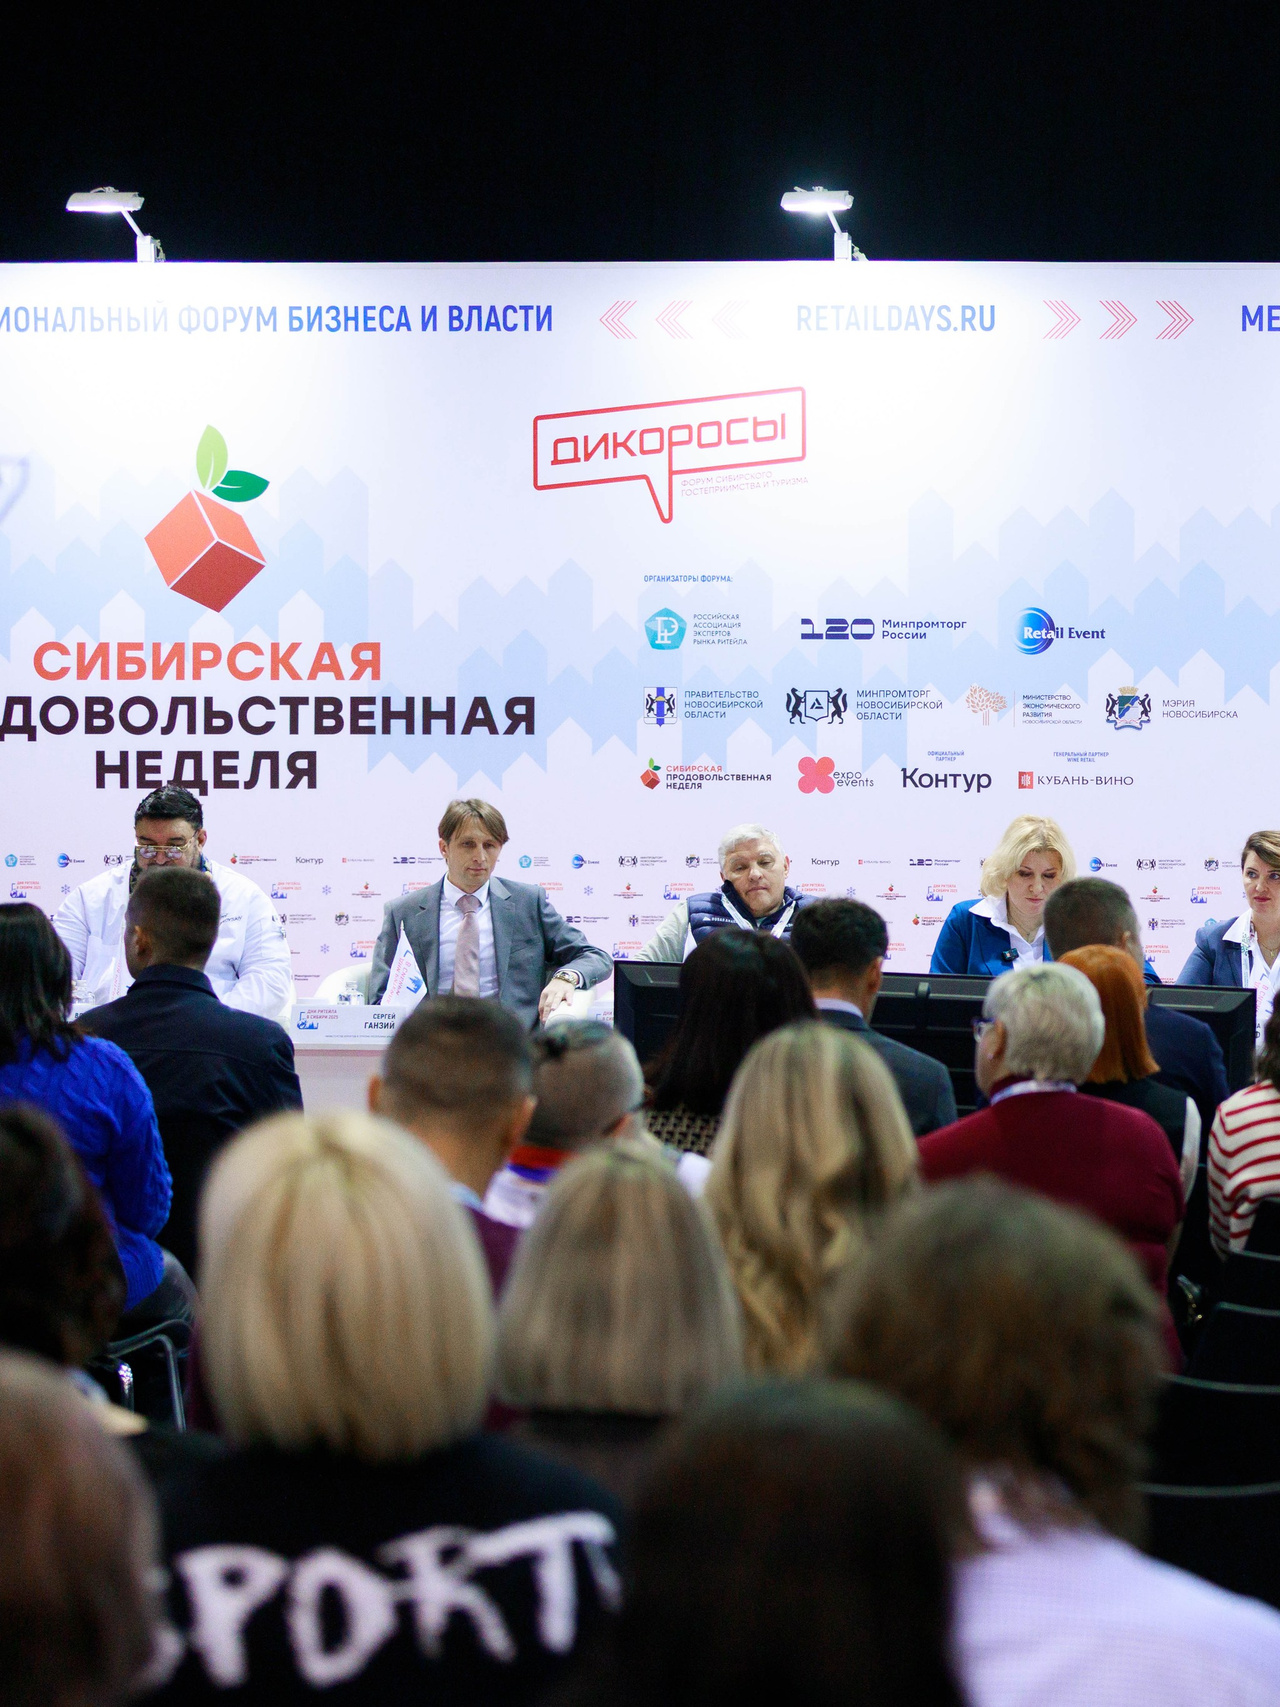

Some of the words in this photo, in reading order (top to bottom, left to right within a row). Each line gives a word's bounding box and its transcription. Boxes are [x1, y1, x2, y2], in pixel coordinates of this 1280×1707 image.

[178, 305, 278, 334] ФОРУМ
[288, 304, 412, 332] БИЗНЕСА
[420, 306, 438, 332] И
[448, 304, 552, 332] ВЛАСТИ
[796, 304, 996, 332] RETAILDAYS.RU
[551, 413, 786, 467] ДИКОРОСЫ
[681, 476, 714, 487] ФОРУМ
[644, 574, 698, 582] ОРГАНИЗАТОРЫ
[694, 612, 740, 620] РОССИЙСКАЯ
[882, 618, 968, 632] Минпромторг
[882, 631, 928, 640] России
[1023, 625, 1065, 641] Retail
[1068, 626, 1106, 640] Event
[34, 642, 380, 682] СИБИРСКАЯ
[684, 690, 760, 698] ПРАВИТЕЛЬСТВО
[856, 690, 928, 698] МИНПРОМТОРГ
[684, 700, 764, 708] НОВОСИБИРСКОЙ
[856, 700, 942, 710] НОВОСИБИРСКОЙ
[1162, 700, 1194, 708] МЭРИЯ
[684, 710, 726, 718] ОБЛАСТИ
[856, 712, 902, 720] ОБЛАСТИ
[1162, 710, 1238, 718] НОВОСИБИРСКА
[0, 696, 536, 742] ДОВОЛЬСТВЕННАЯ
[94, 750, 318, 796] НЕДЕЛЯ
[833, 772, 862, 781] expo
[666, 774, 772, 782] ПРОДОВОЛЬСТВЕННАЯ
[900, 768, 992, 794] Контур
[1038, 776, 1134, 786] КУБАНЬ-ВИНО
[666, 782, 702, 790] НЕДЕЛЯ
[836, 778, 874, 788] events
[364, 1020, 396, 1029] ГАНЗИЙ
[145, 1510, 622, 1690] PORT
